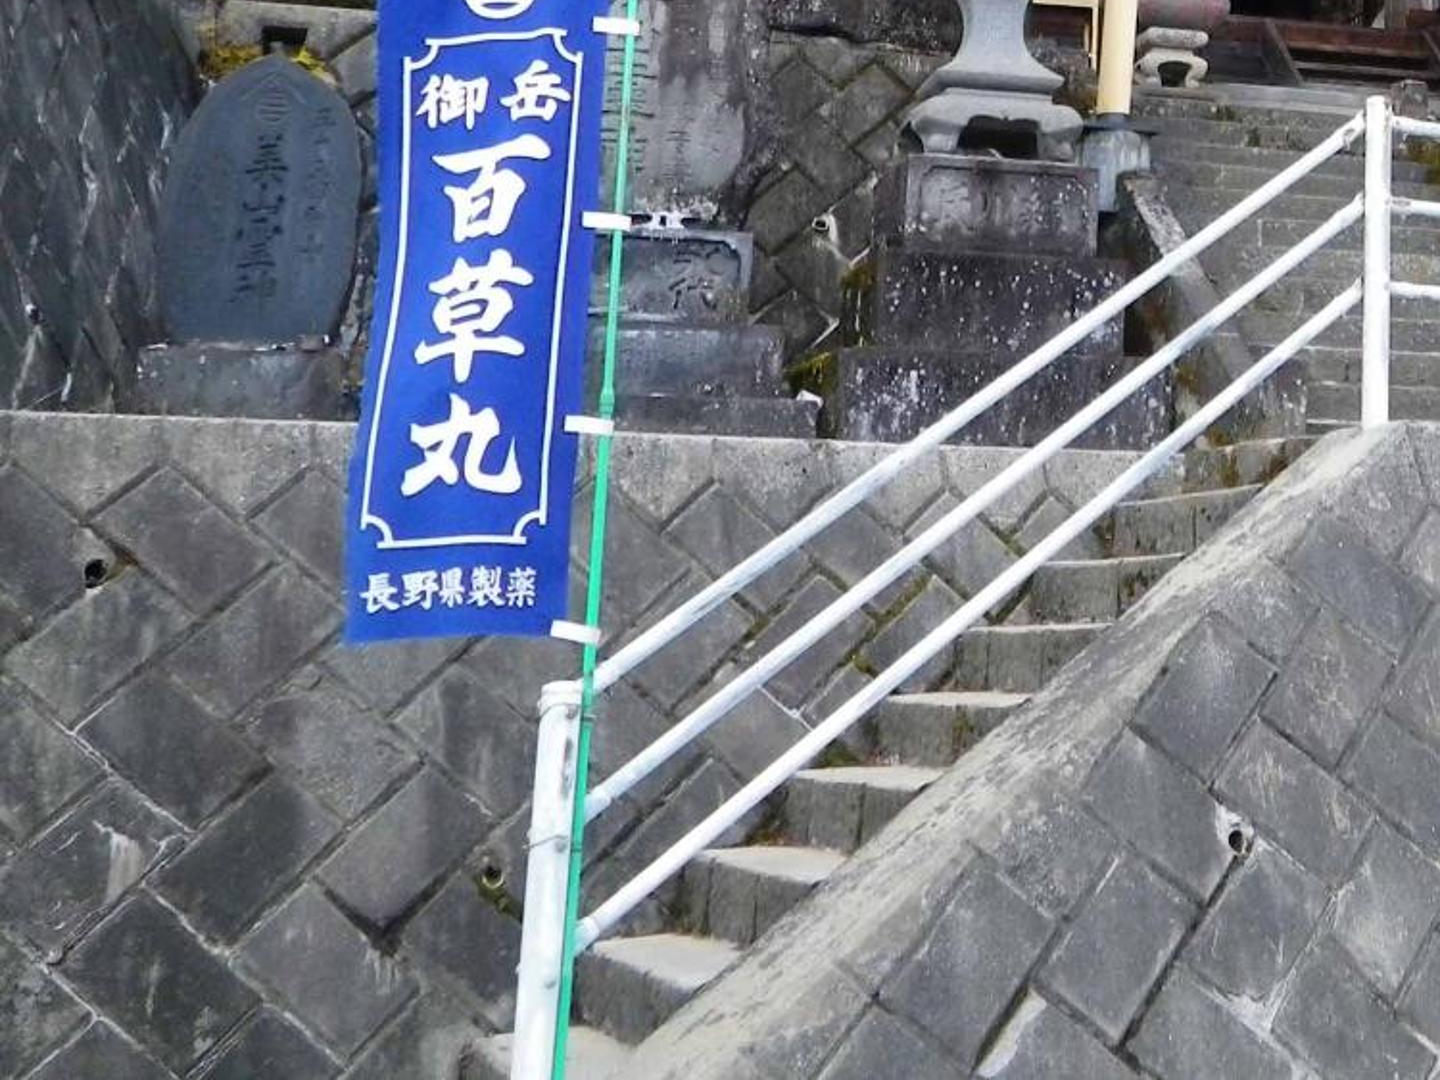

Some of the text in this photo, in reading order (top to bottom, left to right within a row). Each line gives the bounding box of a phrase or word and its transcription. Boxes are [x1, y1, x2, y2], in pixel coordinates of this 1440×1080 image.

[416, 61, 573, 132] 御岳
[401, 134, 551, 495] 百草丸
[360, 566, 538, 613] 長野県製薬
